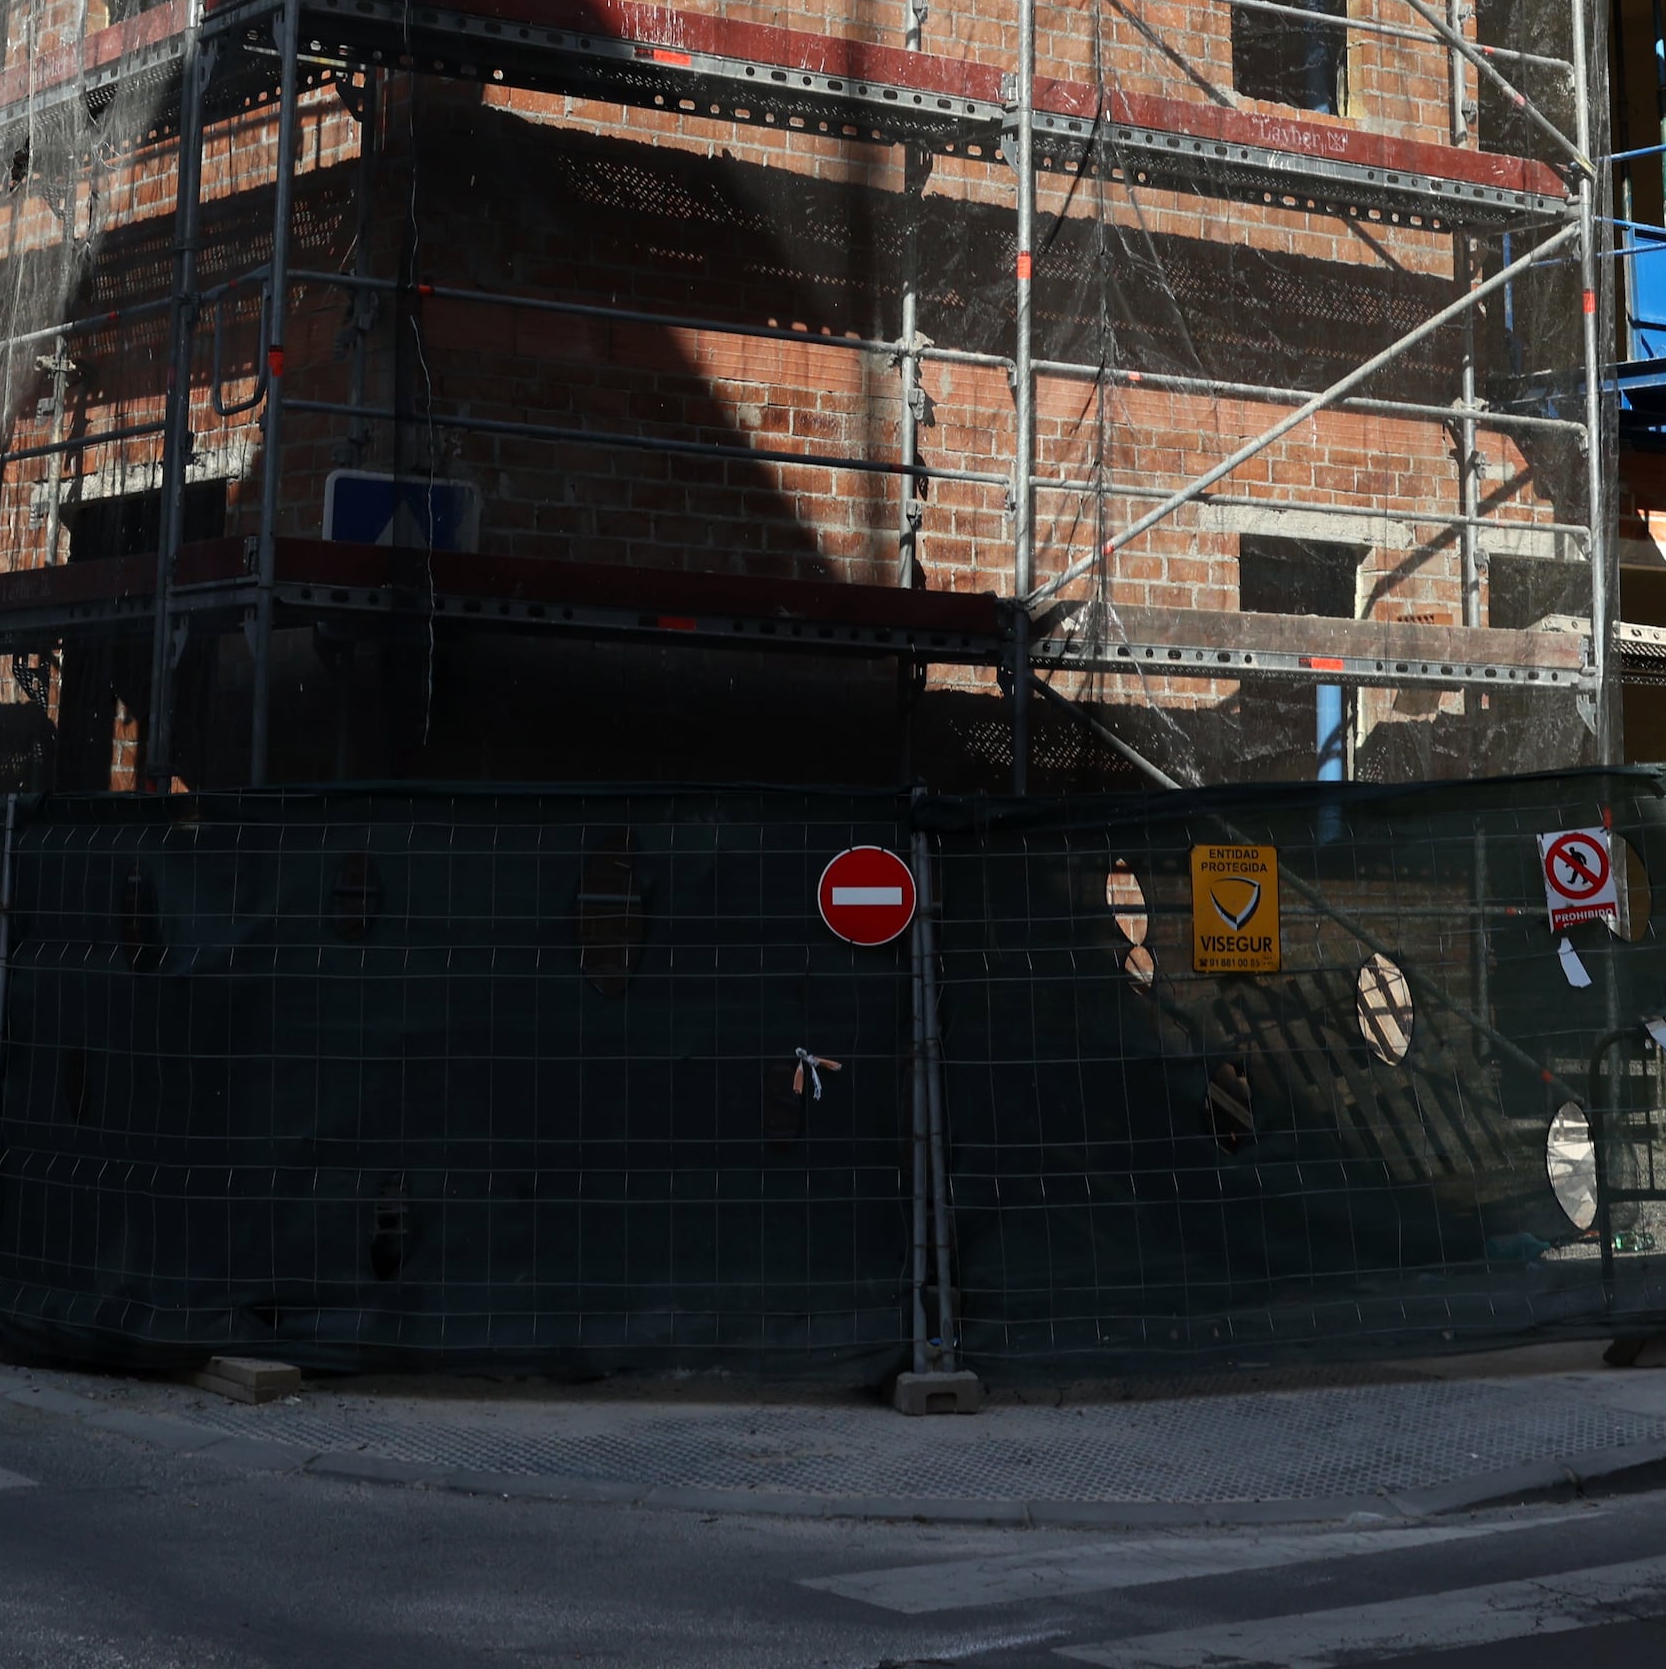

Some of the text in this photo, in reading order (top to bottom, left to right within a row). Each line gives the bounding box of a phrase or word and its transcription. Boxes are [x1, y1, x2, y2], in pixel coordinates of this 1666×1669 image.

[1259, 120, 1321, 148] Layher
[1209, 848, 1259, 859] ENTIDAD
[1201, 862, 1268, 873] PROTEGIDA
[1554, 907, 1613, 923] PROHIBIDO
[1200, 935, 1273, 953] VISEGUR
[1209, 958, 1219, 967] 91
